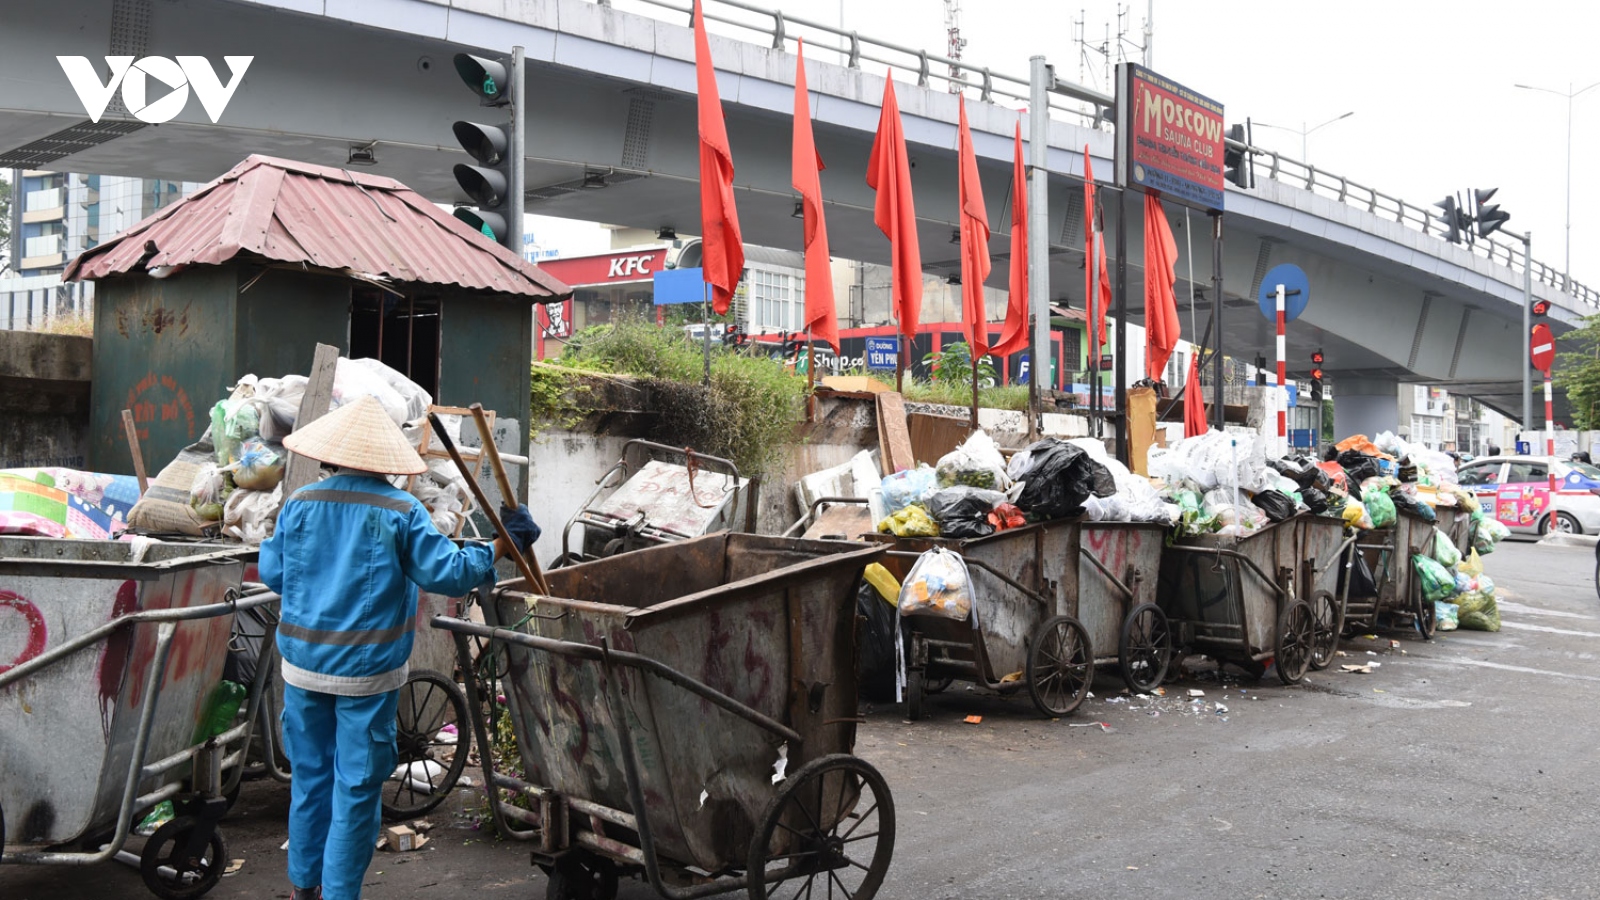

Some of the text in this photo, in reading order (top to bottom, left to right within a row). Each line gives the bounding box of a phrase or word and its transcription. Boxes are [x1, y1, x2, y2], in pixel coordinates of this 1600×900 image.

[1144, 88, 1222, 143] MOSCOW
[1164, 127, 1214, 158] SAUNA CLUB
[608, 254, 653, 278] KFC
[870, 350, 884, 365] YÊN
